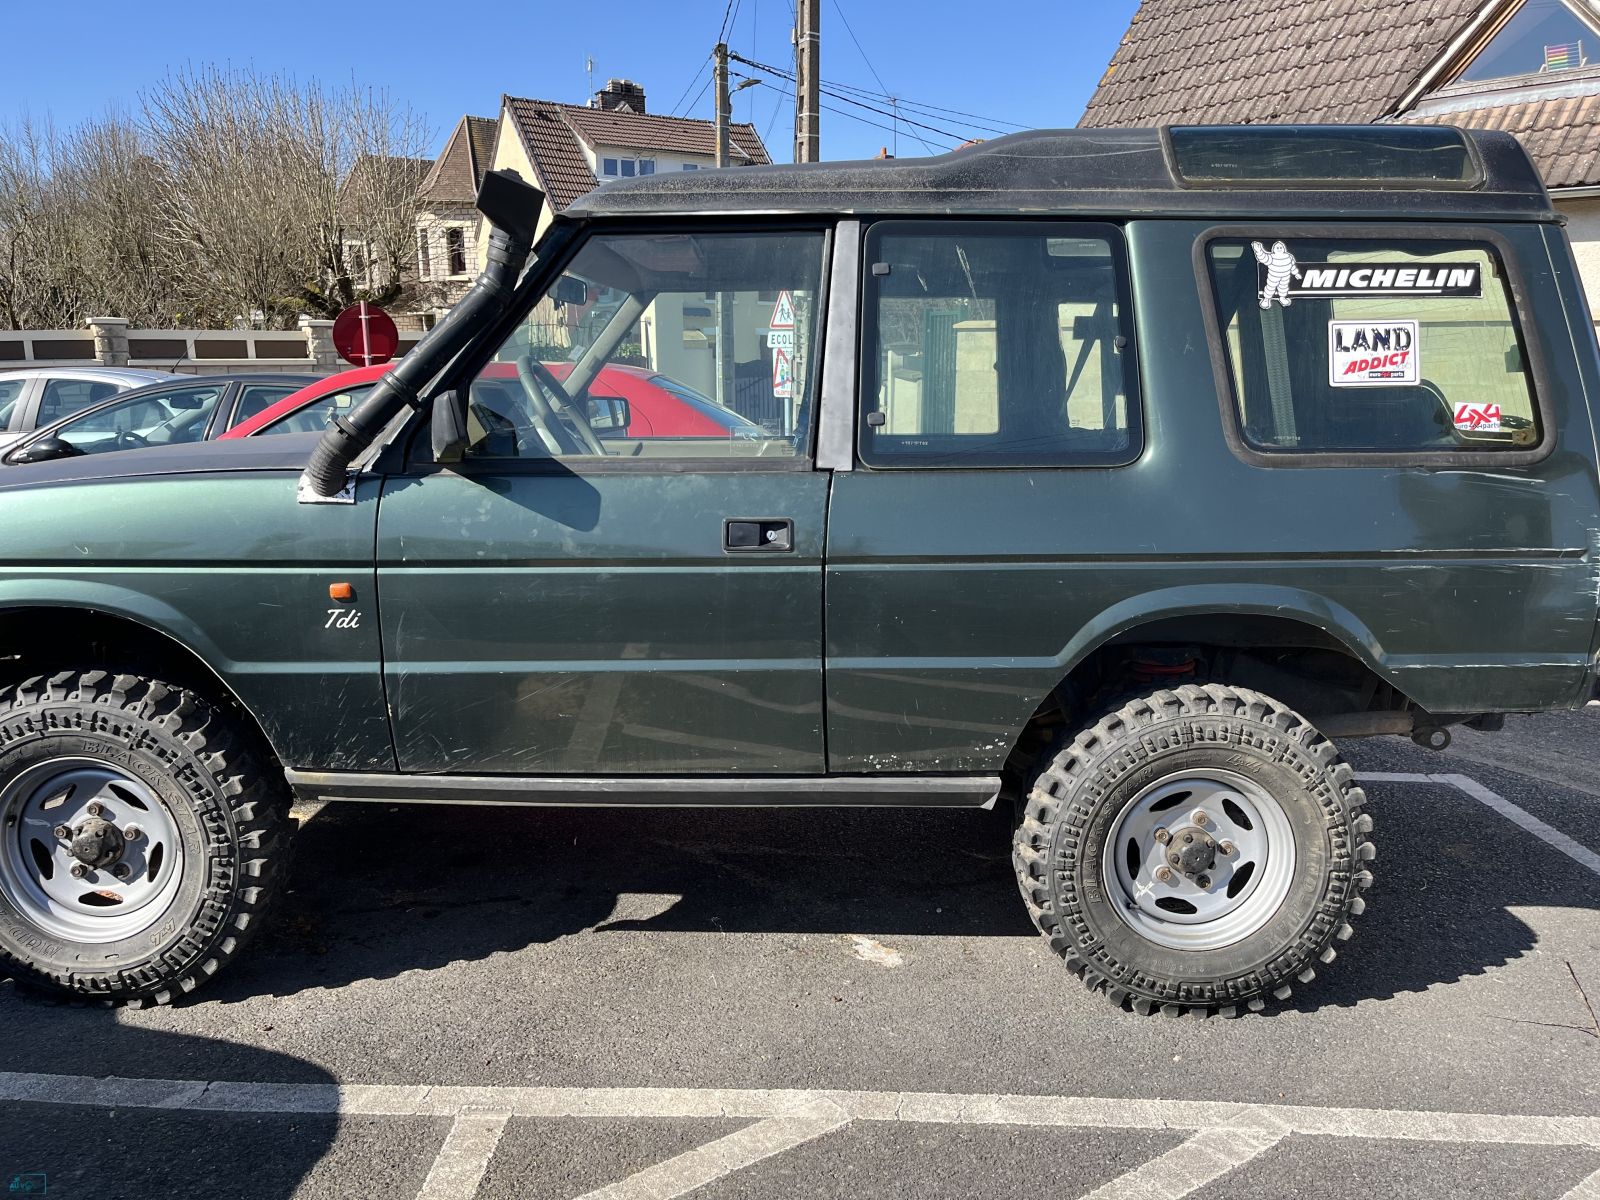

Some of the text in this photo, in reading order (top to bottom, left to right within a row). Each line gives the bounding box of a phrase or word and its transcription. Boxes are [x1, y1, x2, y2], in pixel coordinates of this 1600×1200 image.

[1300, 268, 1475, 288] MICHELIN
[770, 334, 793, 345] ECOL
[1334, 327, 1411, 353] LAND
[1343, 351, 1409, 375] ADDICT
[324, 609, 361, 628] Tdi
